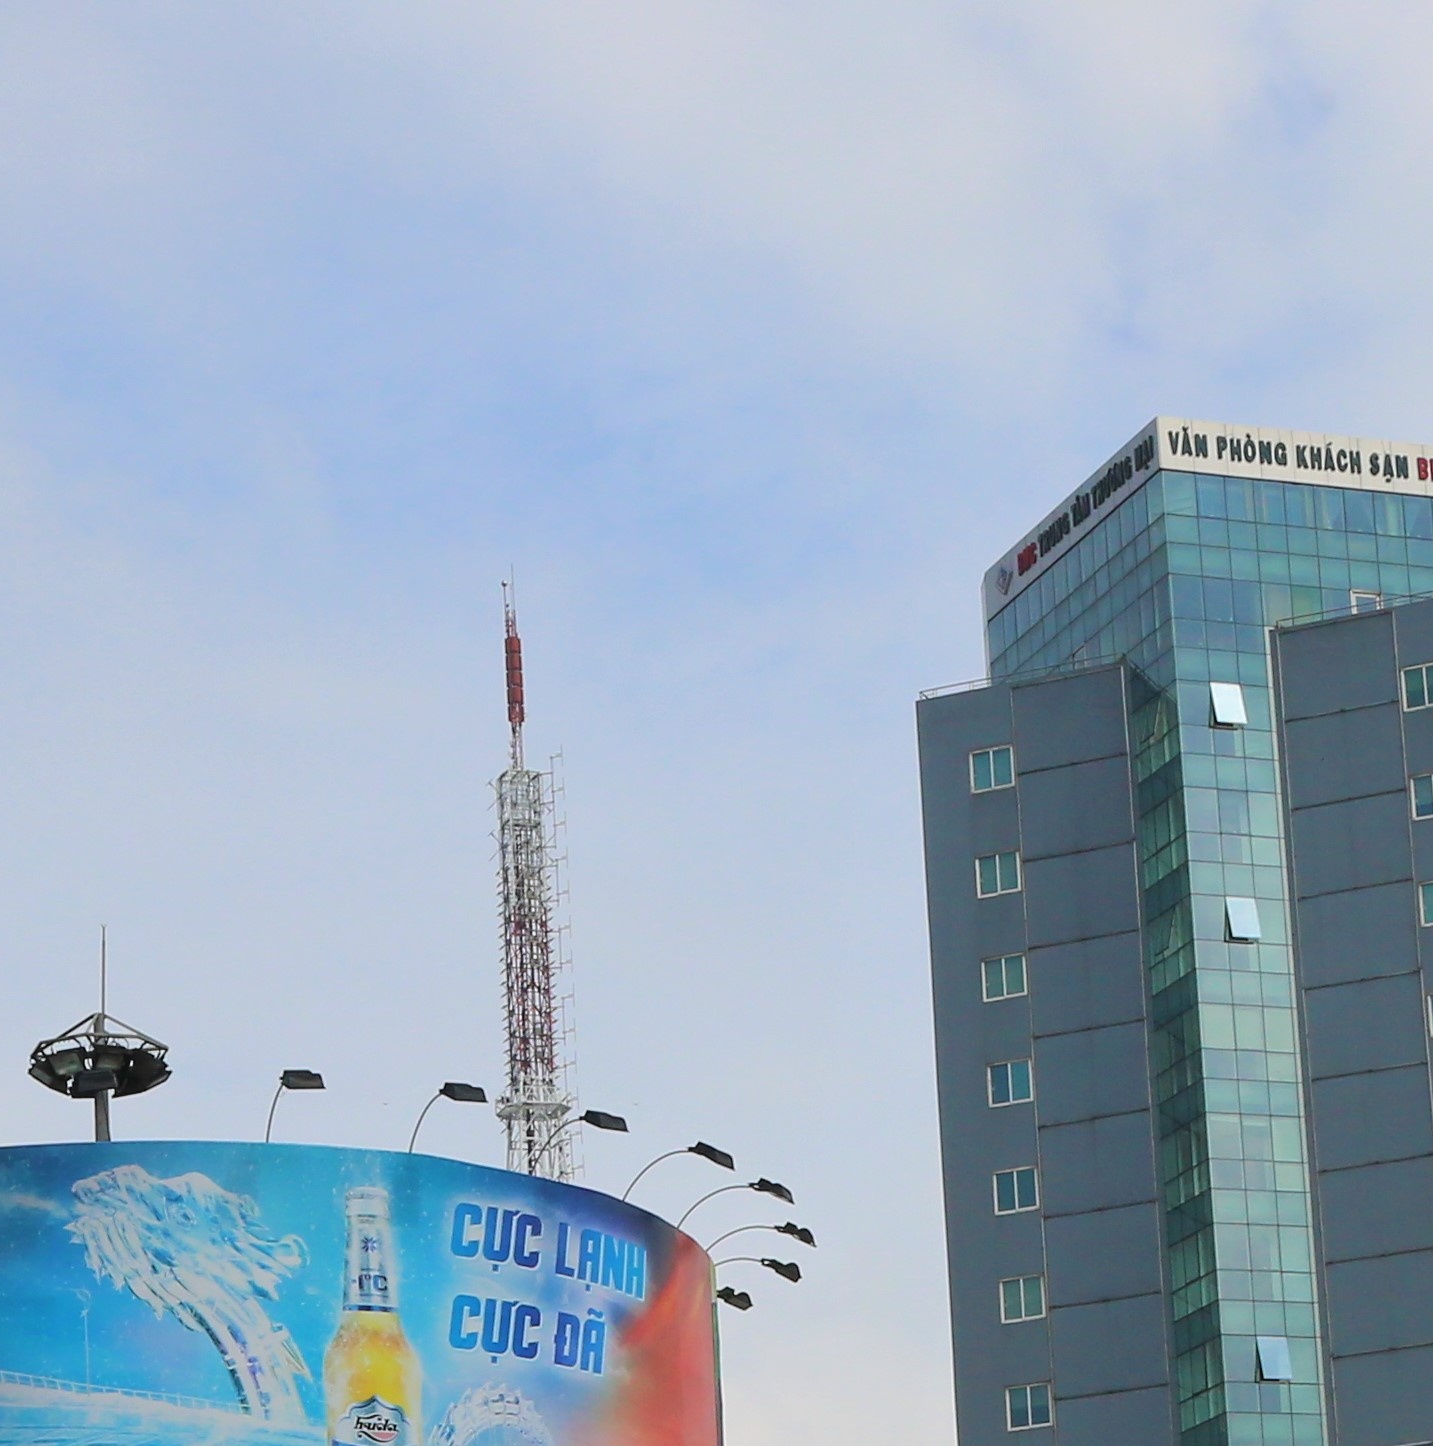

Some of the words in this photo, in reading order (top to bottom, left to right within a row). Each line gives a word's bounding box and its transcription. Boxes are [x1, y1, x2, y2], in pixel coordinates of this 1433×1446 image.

[1168, 426, 1208, 459] VĂN
[1217, 433, 1287, 466] PHÒNG
[1296, 441, 1362, 475] KHÁCH
[1369, 453, 1409, 484] SẠN
[450, 1202, 543, 1273] CỰC
[554, 1221, 647, 1301] LẠNH
[448, 1293, 542, 1365] CỰC
[553, 1307, 606, 1375] ĐÃ
